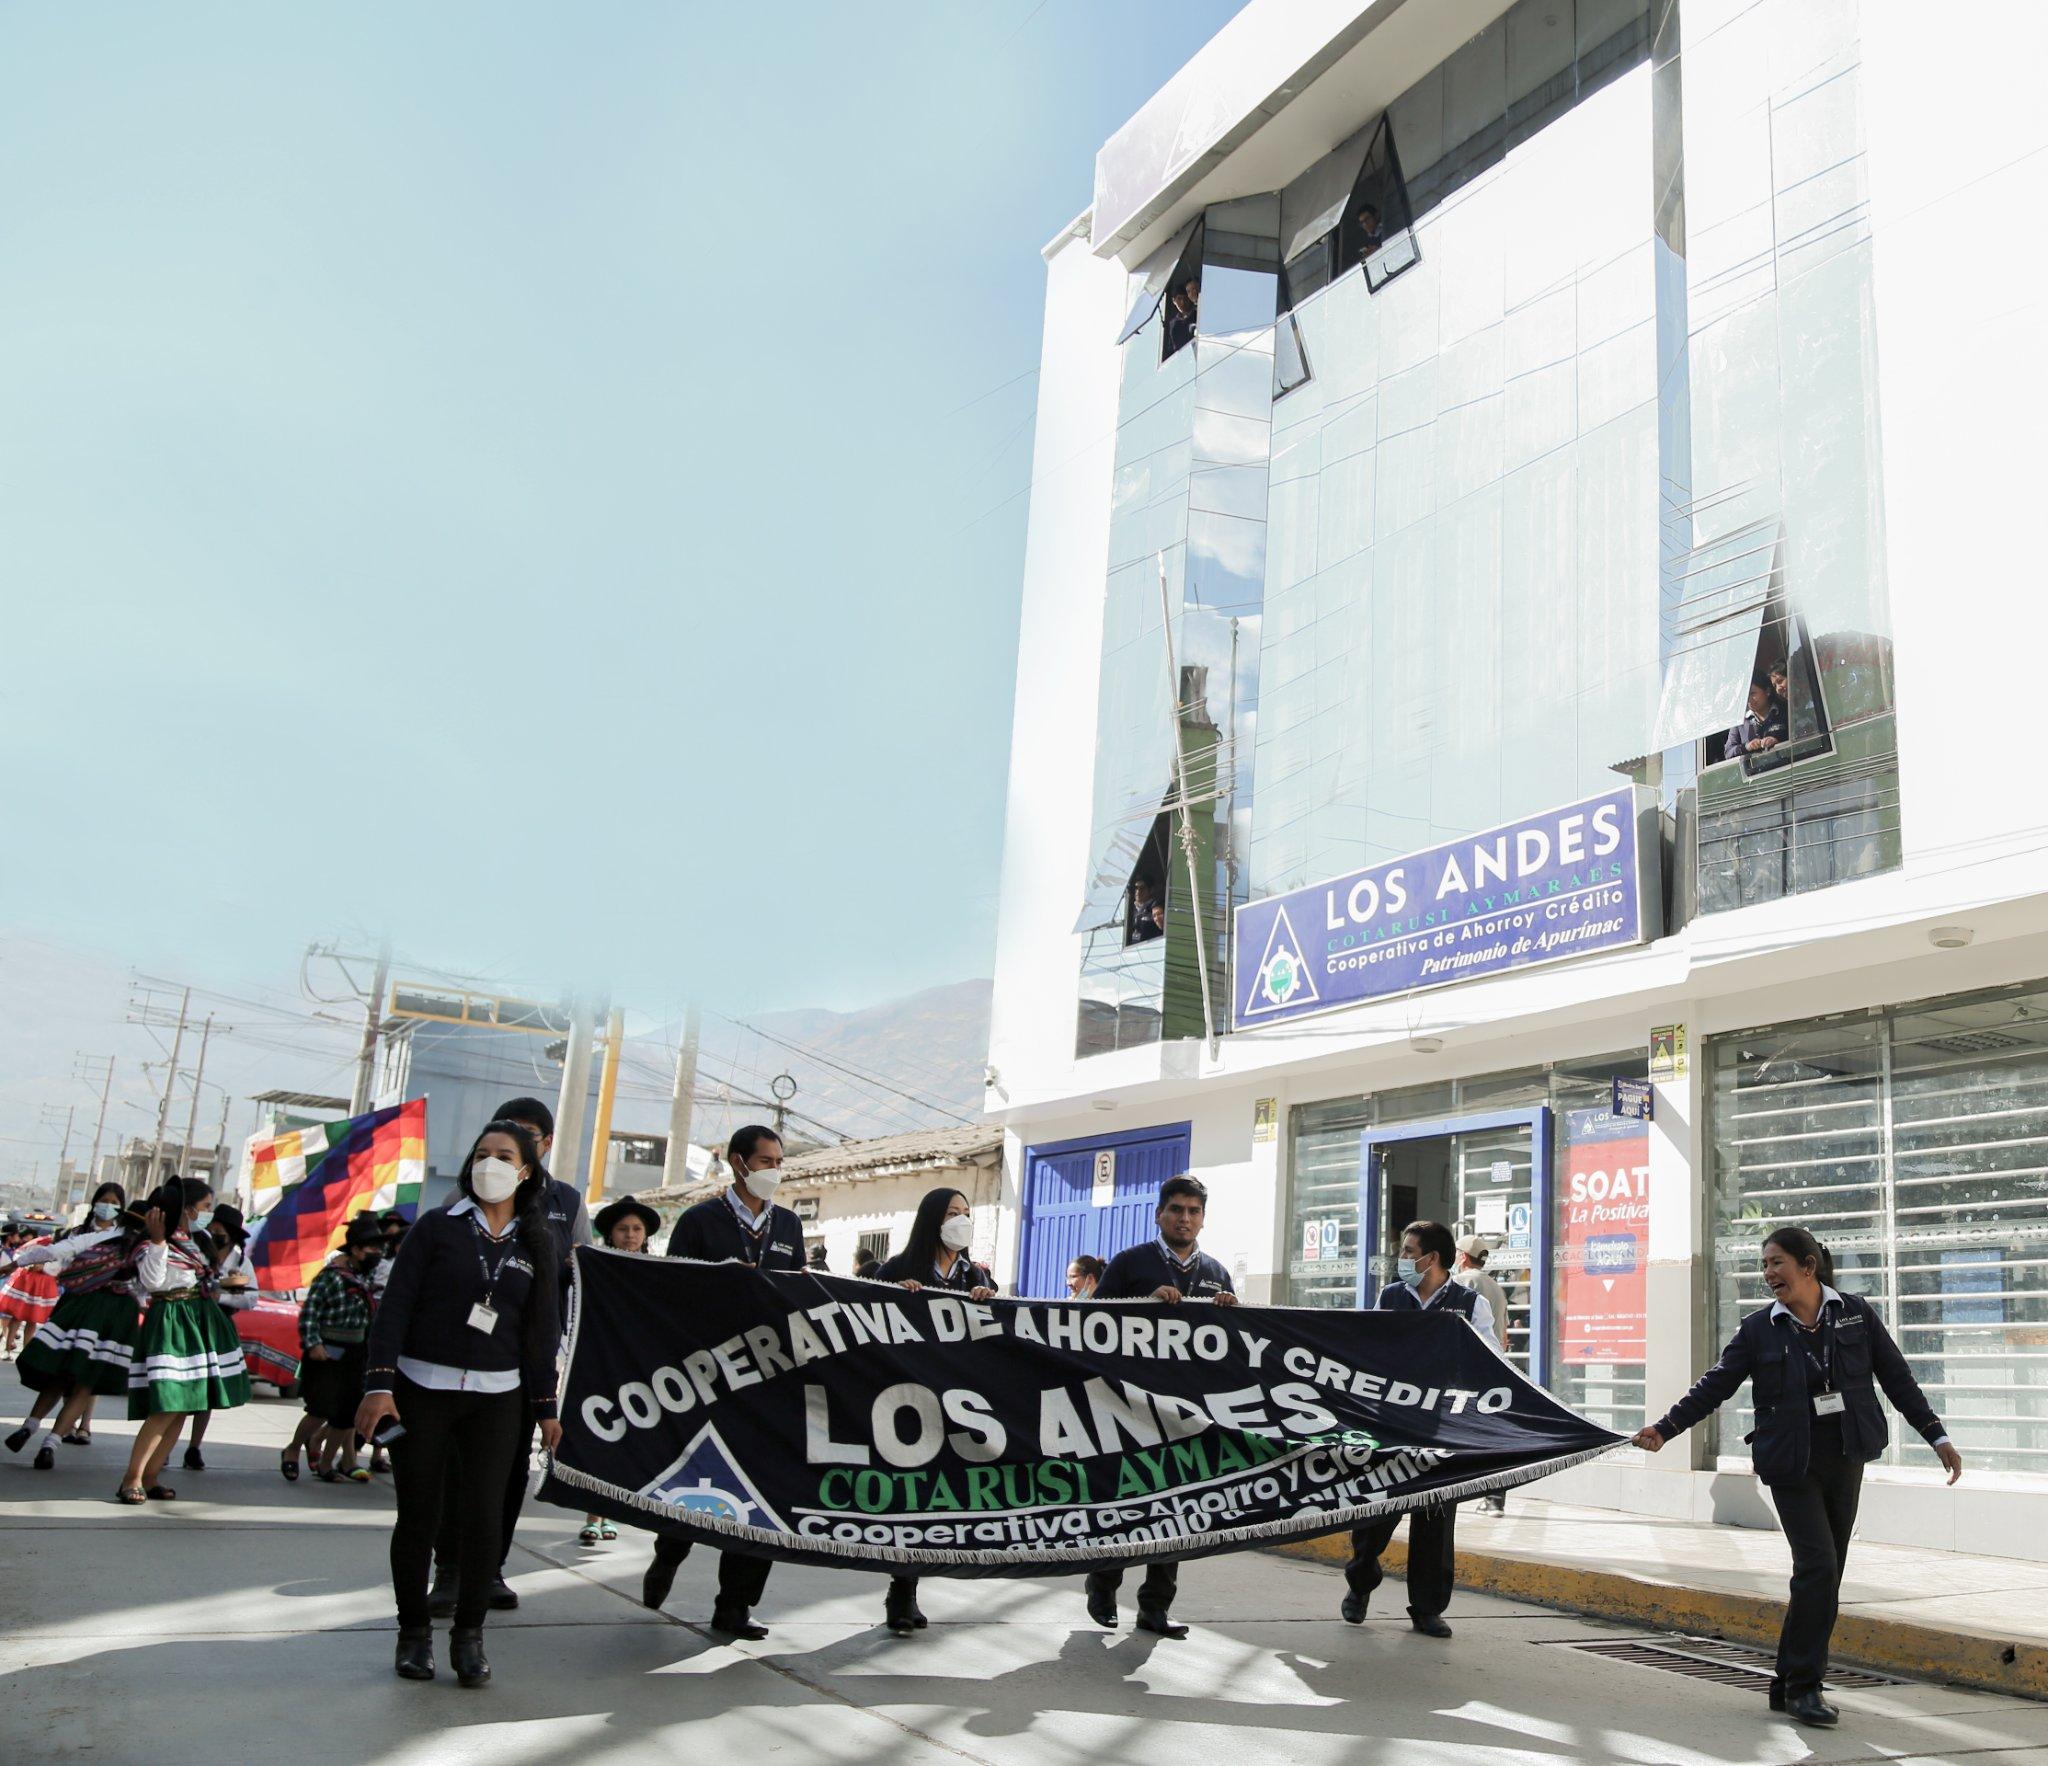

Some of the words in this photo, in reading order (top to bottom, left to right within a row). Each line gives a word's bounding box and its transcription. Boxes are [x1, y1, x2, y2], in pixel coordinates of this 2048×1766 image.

[1327, 868, 1407, 931] LOS
[1435, 804, 1621, 900] ANDES
[1326, 938, 1428, 974] Cooperativa
[1434, 931, 1455, 948] de
[1545, 889, 1623, 920] Crédito
[1327, 908, 1449, 952] COTARUSI
[1467, 862, 1622, 915] AYMARAES
[1420, 942, 1508, 976] Patrimonio
[1510, 936, 1532, 954] de
[1533, 916, 1624, 952] Apurímac
[1594, 1112, 1610, 1121] LOS
[1617, 1092, 1642, 1104] PAGUE
[1571, 1166, 1649, 1202] SOAT
[1570, 1206, 1588, 1223] La
[1591, 1202, 1649, 1224] Positiva
[581, 1300, 925, 1443] COOPERATIVA
[928, 1297, 1003, 1343] DE
[1013, 1307, 1228, 1362] AHORRO
[1238, 1330, 1271, 1368] Y
[1283, 1346, 1513, 1415] CREDITO
[804, 1382, 1008, 1468] LOS
[819, 1458, 1093, 1513] COTARUSI
[797, 1508, 1092, 1547] Cooperativa
